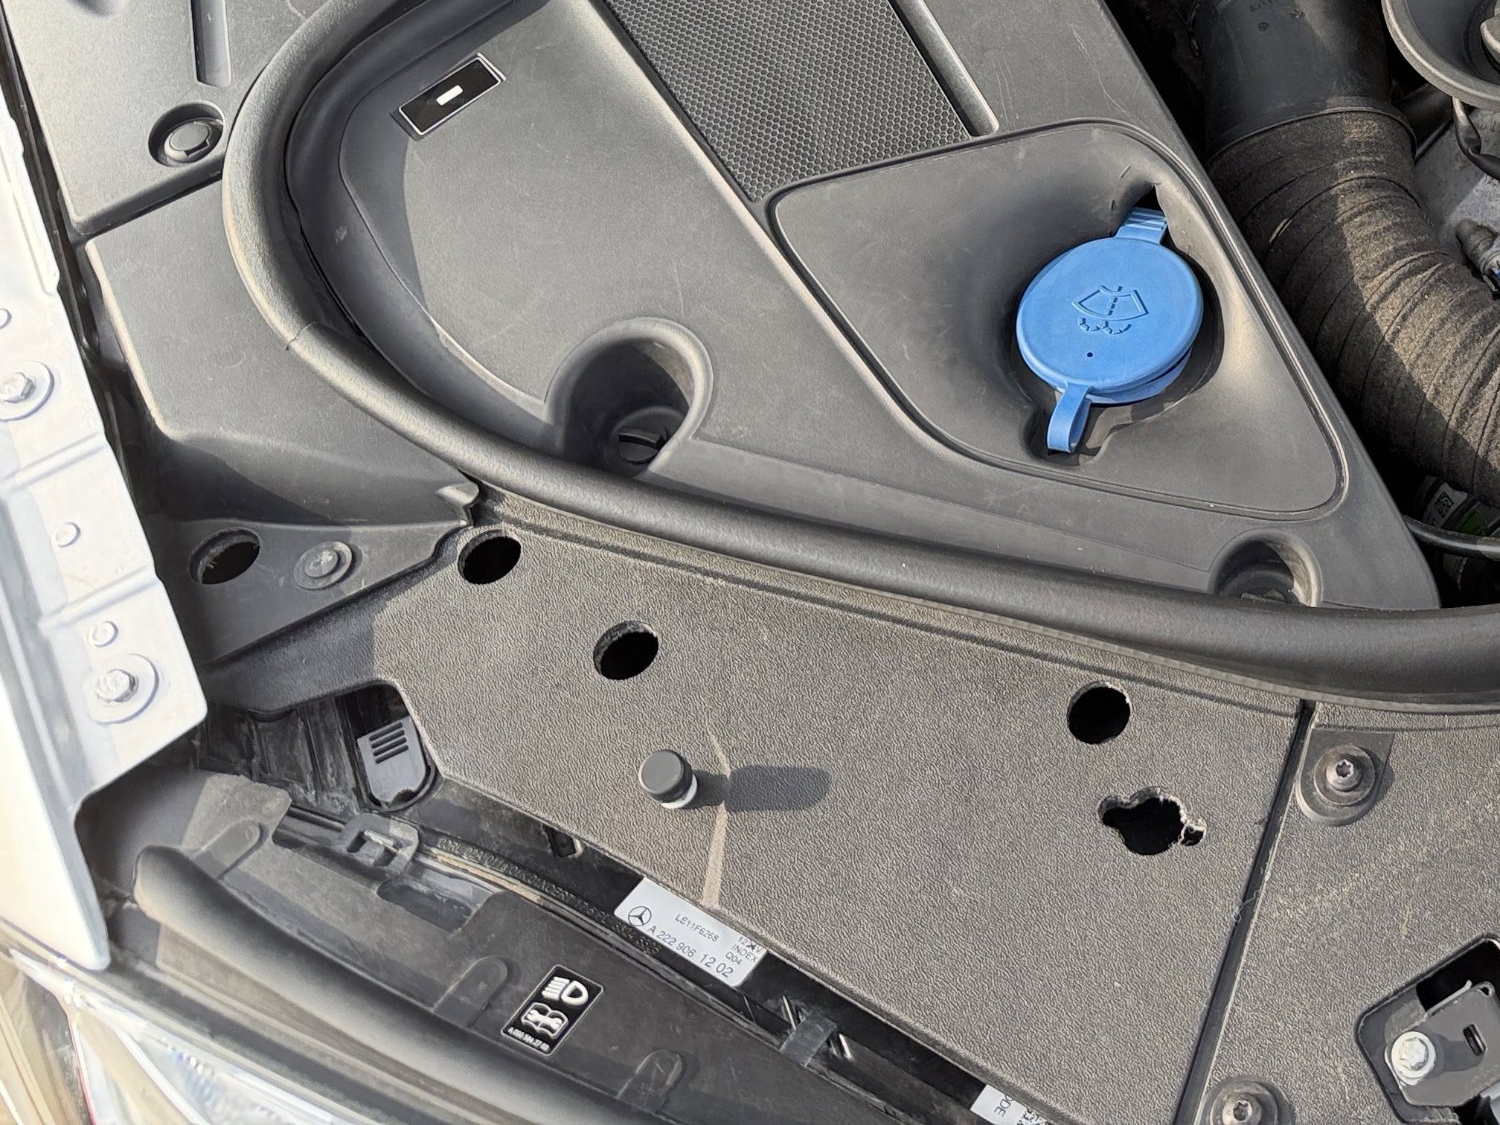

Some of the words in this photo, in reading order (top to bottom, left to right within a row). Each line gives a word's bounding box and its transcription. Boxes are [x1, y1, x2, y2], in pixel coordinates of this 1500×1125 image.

[675, 913, 720, 942] LE11F6268
[647, 925, 657, 935] A
[656, 930, 677, 946] 222
[676, 942, 697, 958] 906
[699, 953, 717, 969] 12
[716, 962, 734, 978] 02
[732, 944, 760, 963] INDEX
